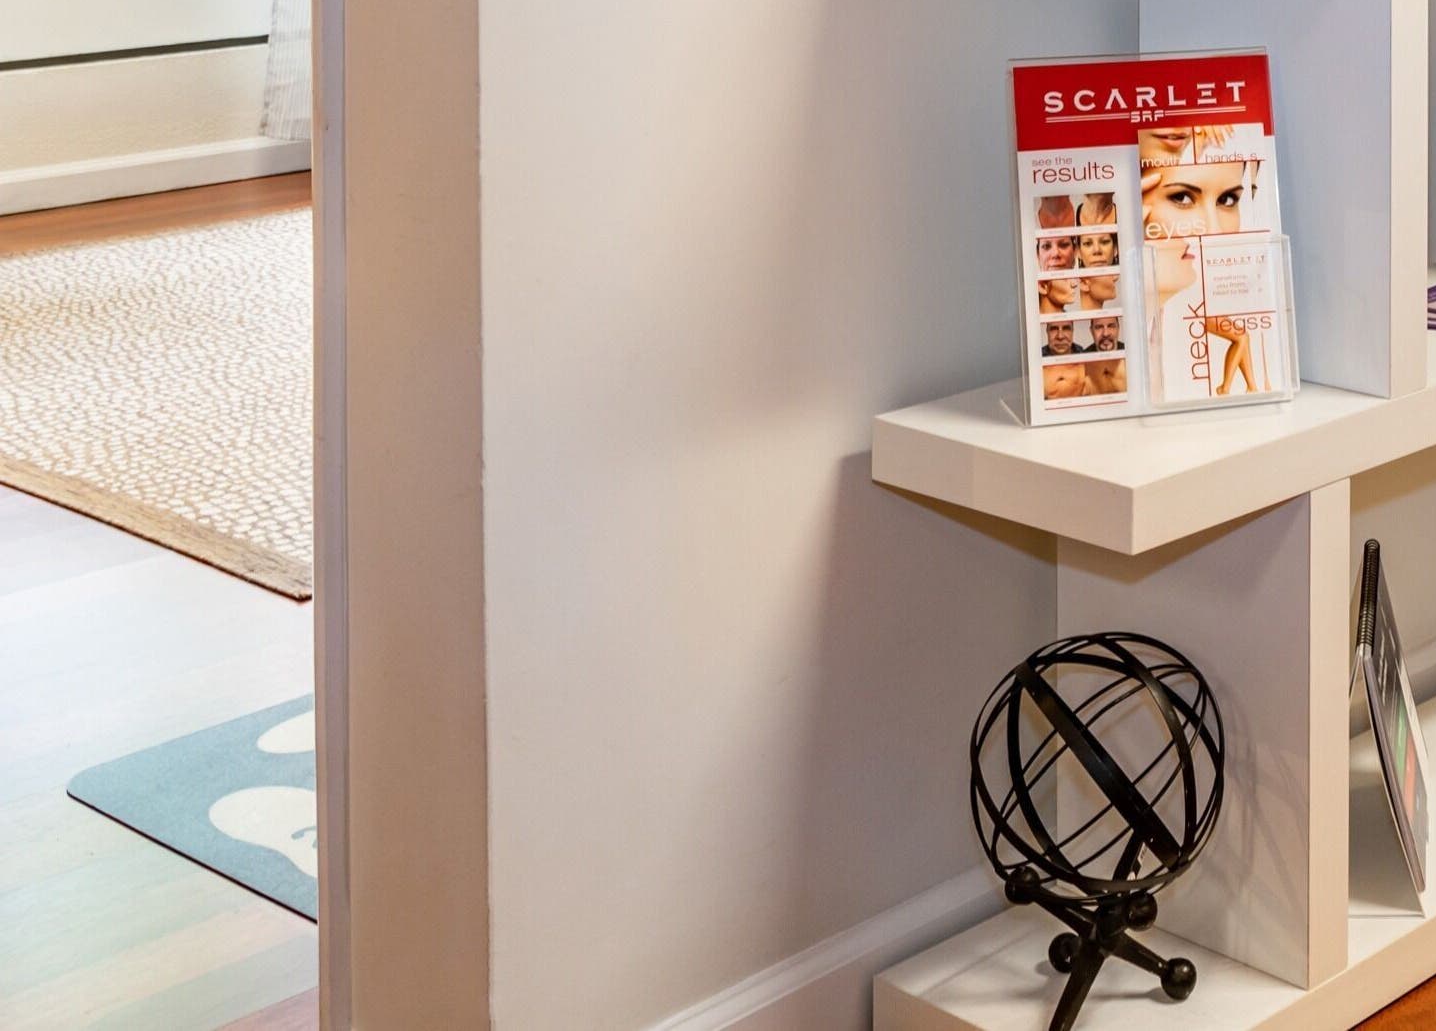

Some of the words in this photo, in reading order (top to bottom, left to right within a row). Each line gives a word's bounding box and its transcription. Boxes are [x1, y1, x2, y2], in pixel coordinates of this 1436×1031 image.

[1044, 81, 1246, 113] SCARLET
[1130, 110, 1165, 123] SRF
[1032, 158, 1052, 166] see
[1054, 156, 1073, 166] the
[1033, 161, 1115, 184] results
[1141, 154, 1180, 168] mouth
[1145, 219, 1207, 242] eyes
[1187, 300, 1209, 380] neck
